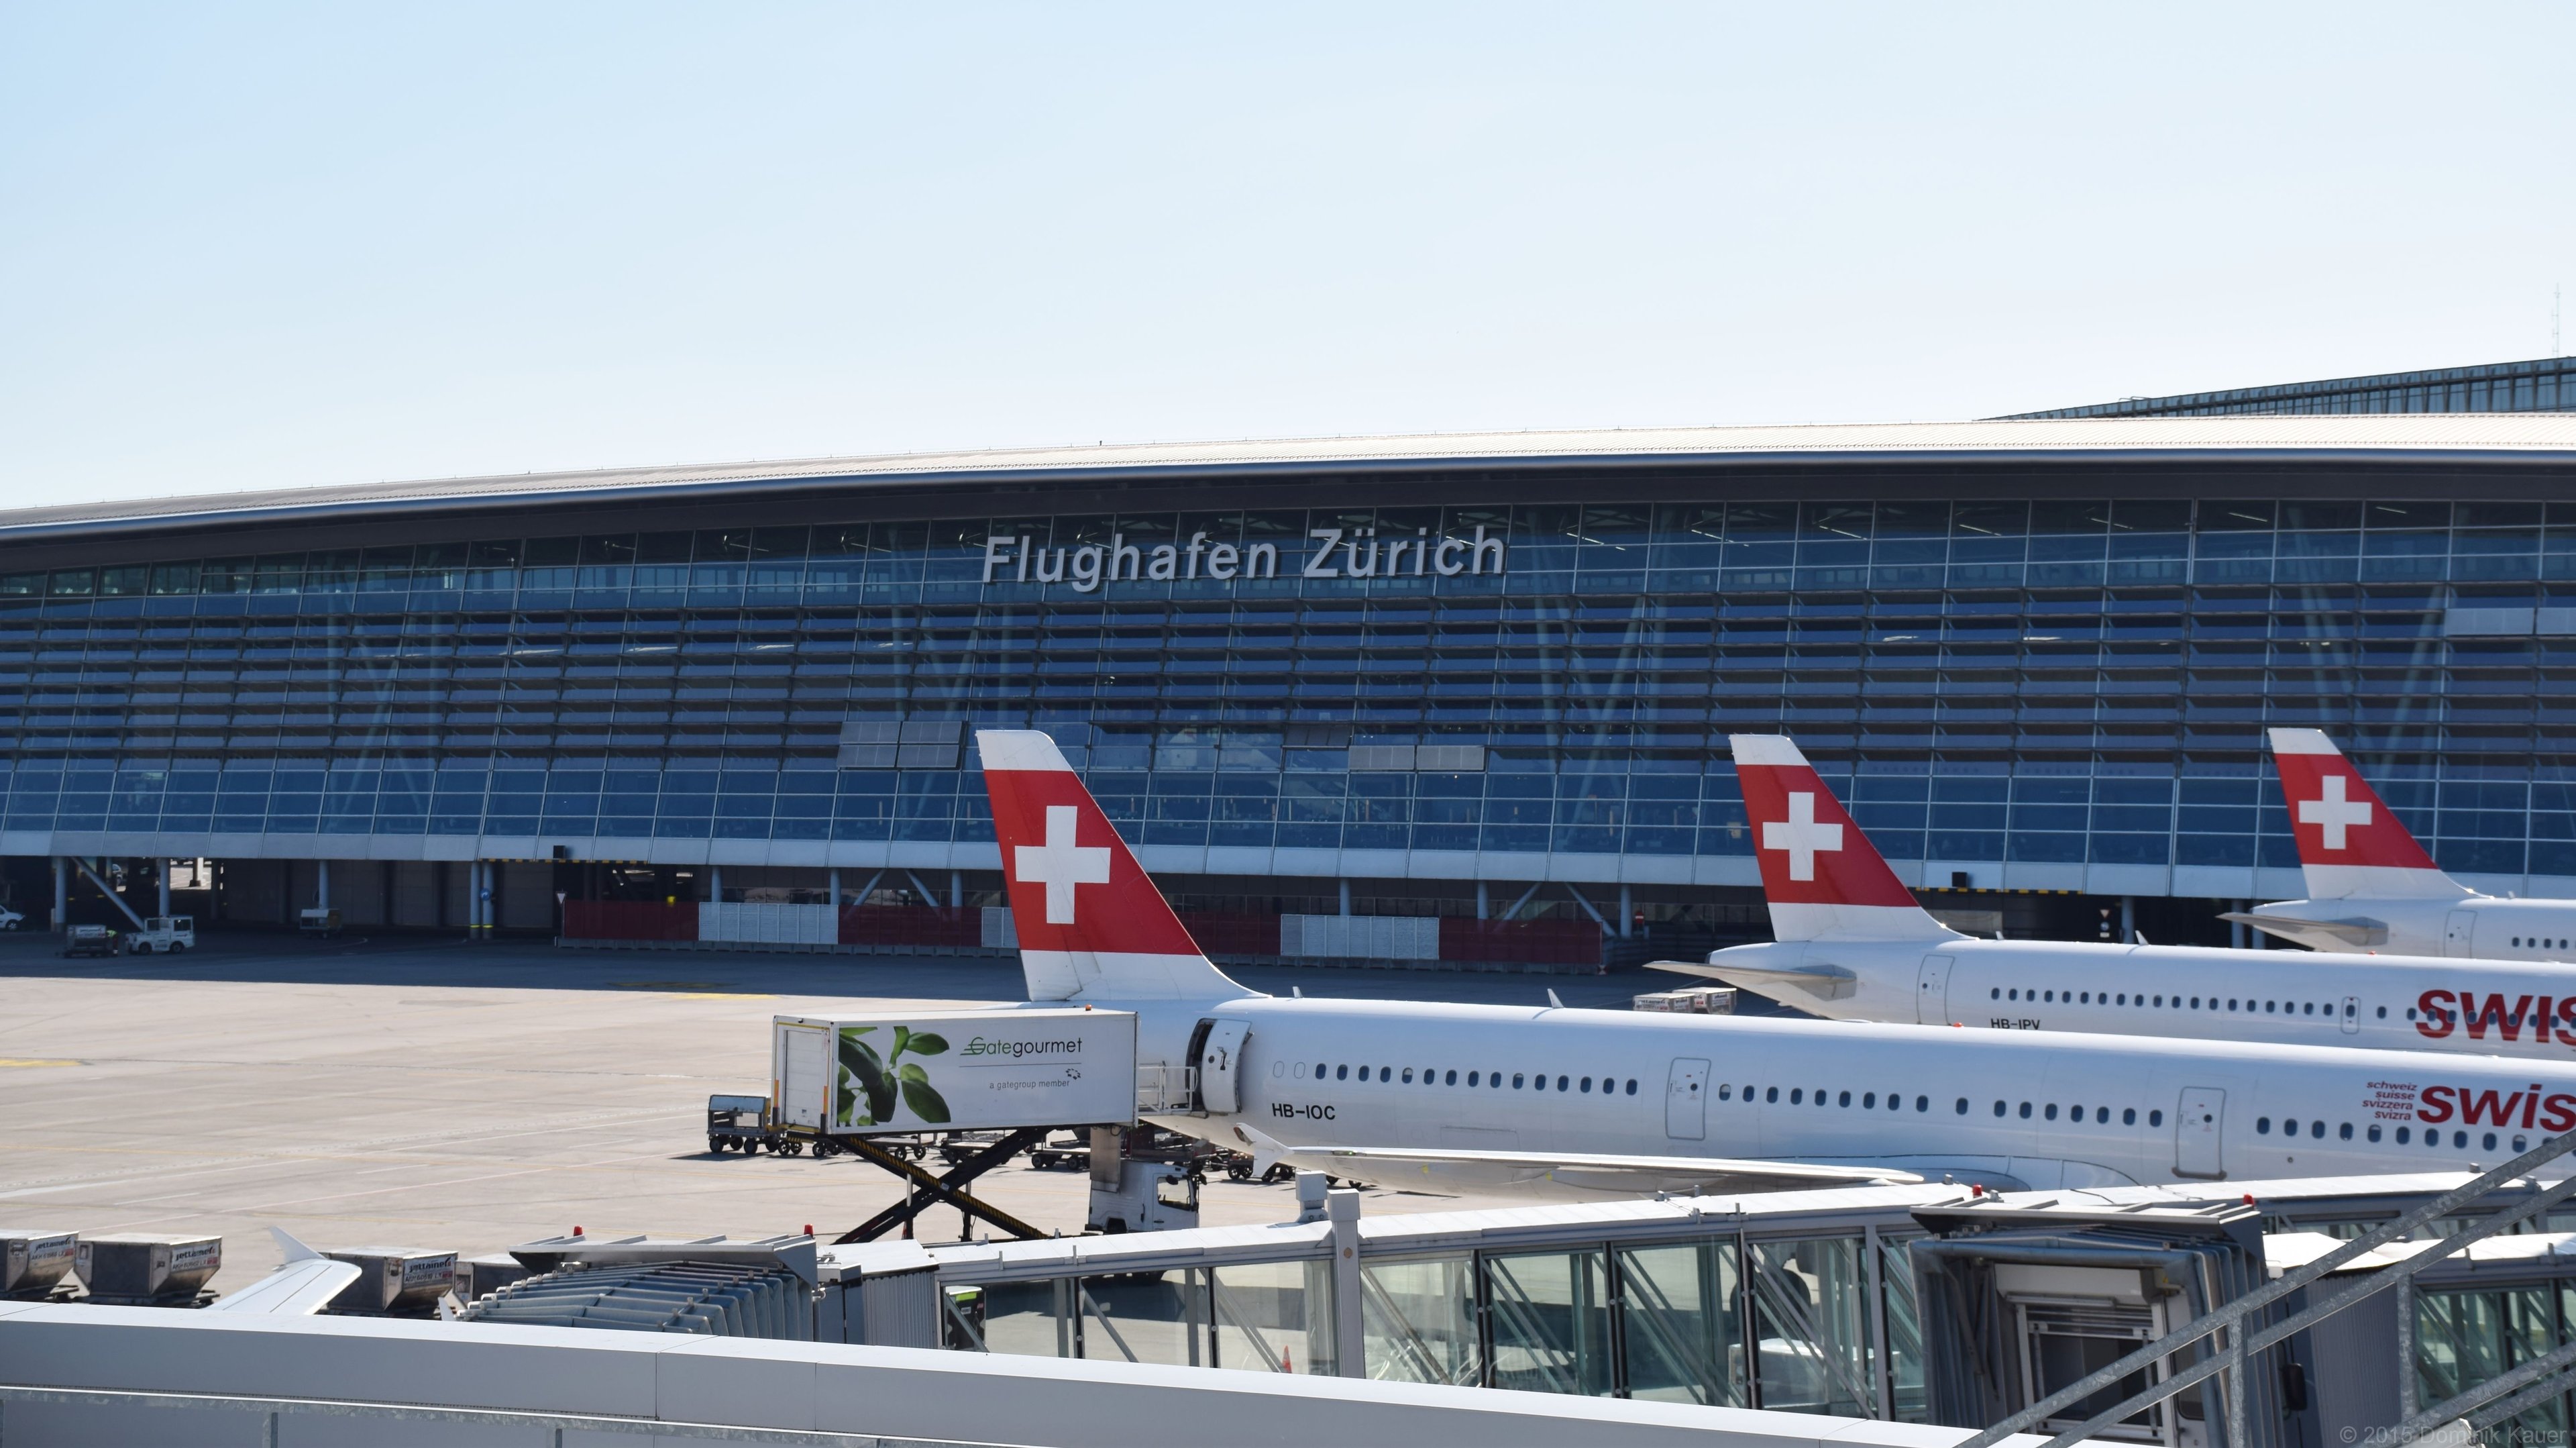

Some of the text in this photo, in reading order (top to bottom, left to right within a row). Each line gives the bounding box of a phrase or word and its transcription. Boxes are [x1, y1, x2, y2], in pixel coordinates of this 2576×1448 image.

[981, 525, 1505, 593] Flughafen Zürich
[1990, 1018, 2040, 1030] HB-IPV
[959, 1037, 1082, 1057] Gategourmet
[998, 1081, 1036, 1090] gategroup
[1038, 1079, 1070, 1088] member
[2366, 1080, 2417, 1092] schweiz
[2375, 1090, 2415, 1100] suisse
[2361, 1098, 2414, 1110] svizzera
[1271, 1102, 1336, 1120] HB-IOC
[2374, 1109, 2412, 1121] svizra
